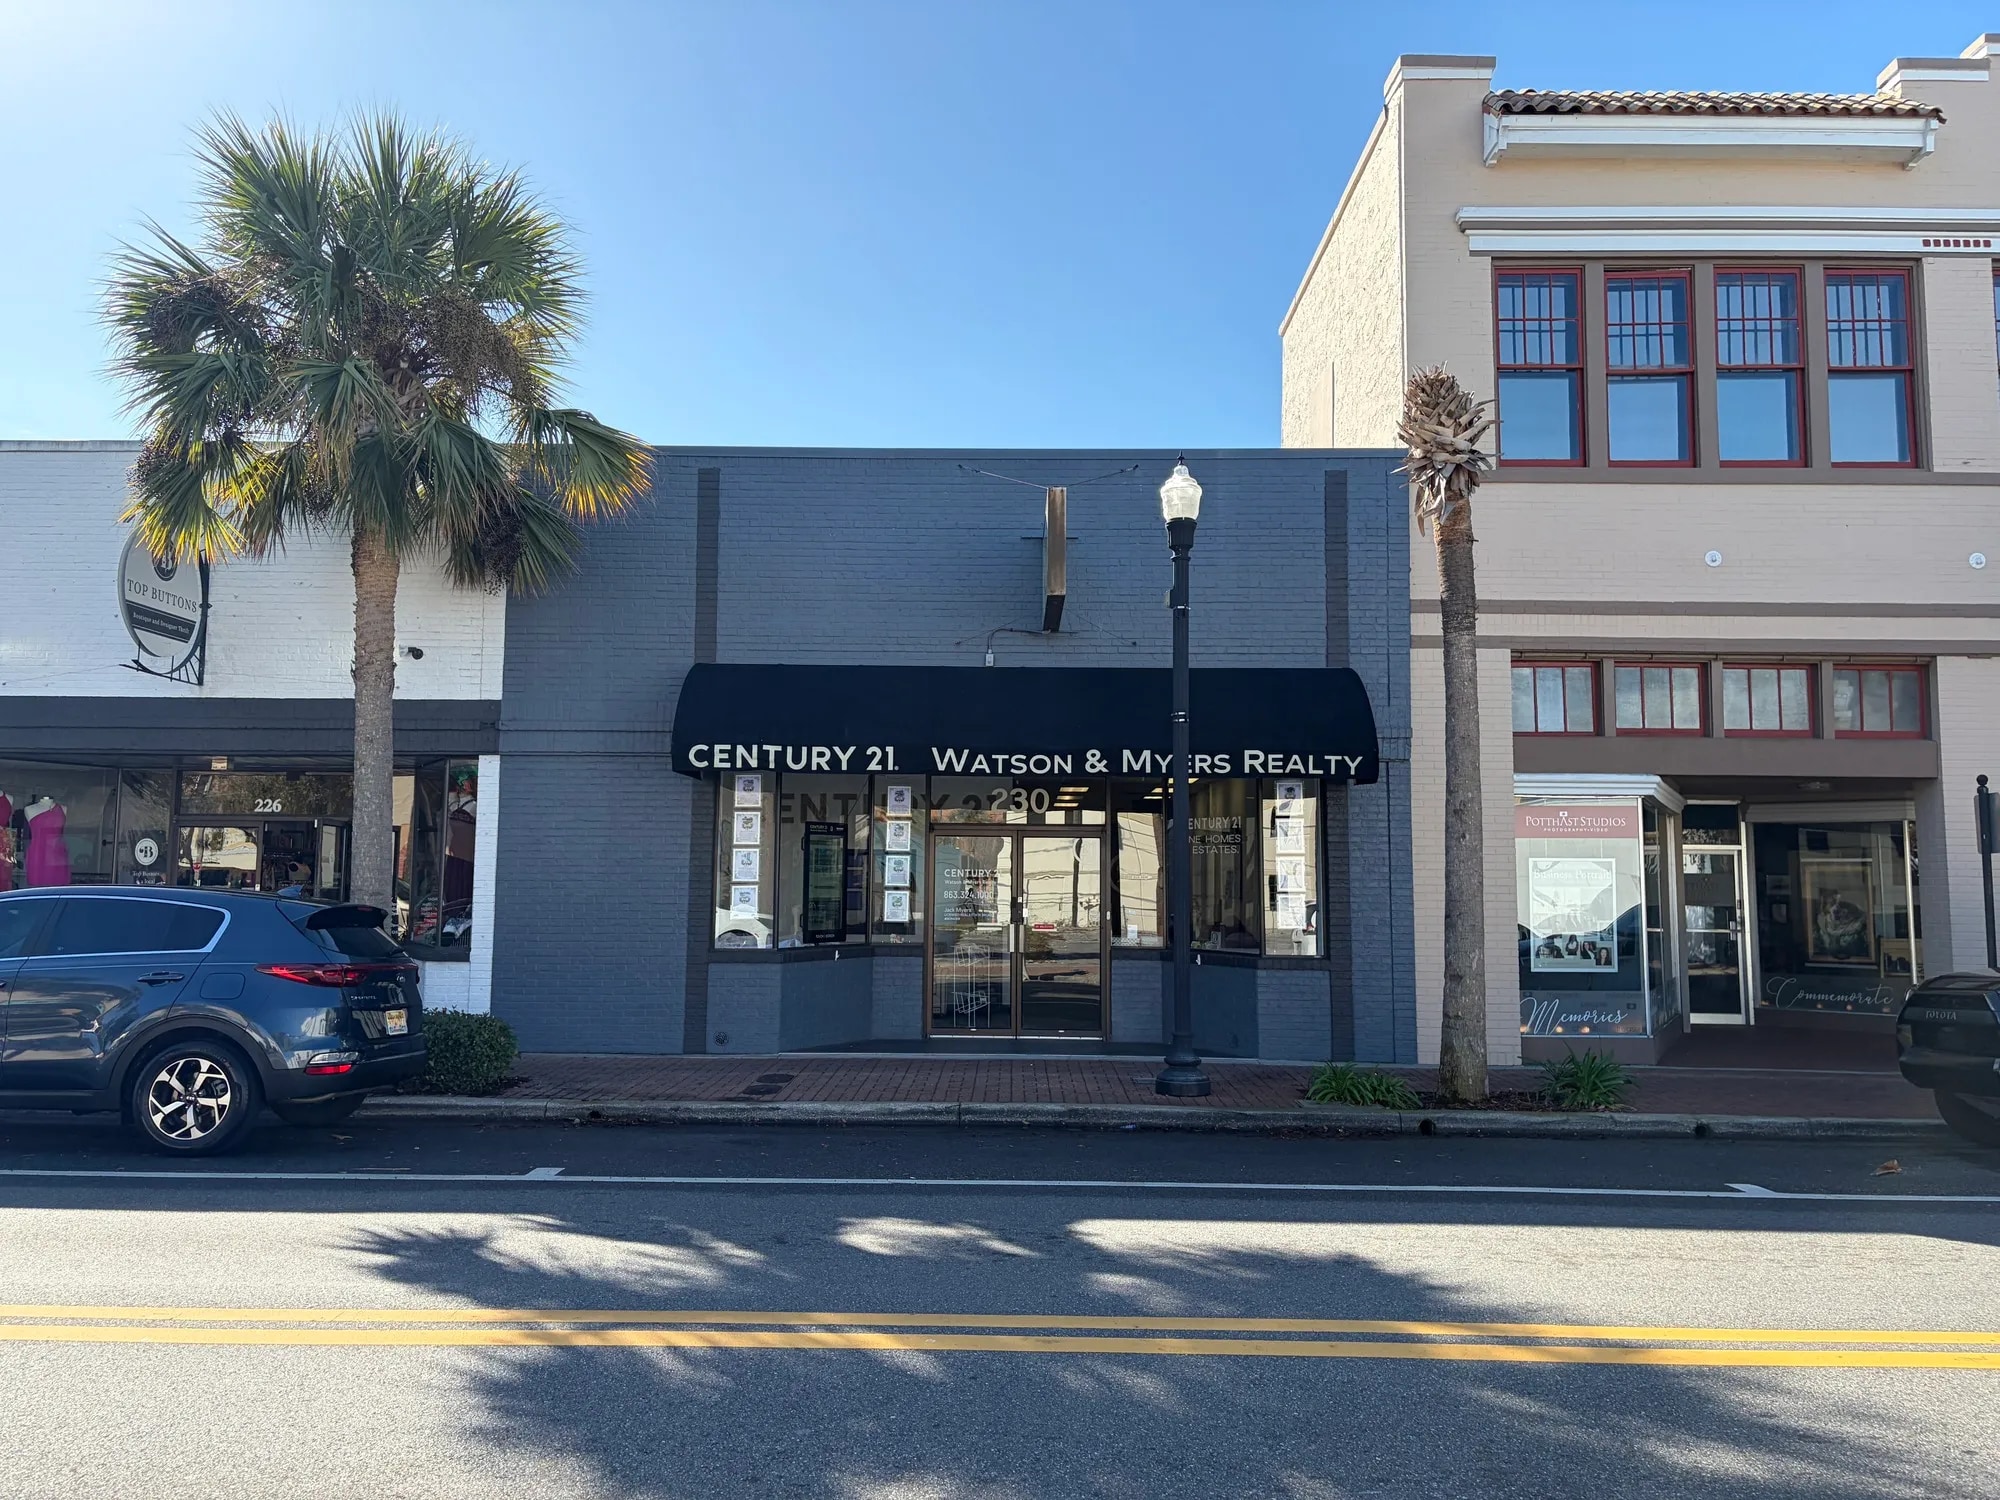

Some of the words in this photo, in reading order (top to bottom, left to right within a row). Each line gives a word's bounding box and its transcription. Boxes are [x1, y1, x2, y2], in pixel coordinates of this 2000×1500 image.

[127, 579, 148, 596] TOP
[151, 587, 197, 613] BUTTONS
[688, 744, 856, 771] CENTURY
[931, 747, 1072, 774] WATSON
[1084, 749, 1109, 774] &
[1122, 749, 1231, 774] MYRS
[1244, 749, 1363, 776] REALTY
[254, 799, 282, 812] 226
[991, 788, 1050, 814] 230
[1188, 816, 1229, 830] ENTURY
[1232, 816, 1241, 829] 21
[1525, 816, 1579, 827] POTTHAST
[1580, 816, 1626, 827] STUDIOS
[1189, 835, 1201, 844] NE
[1205, 834, 1242, 844] HOMES
[944, 868, 991, 878] CENTURY
[1766, 976, 1894, 1008] Commemorate
[1519, 997, 1628, 1035] Memories
[1925, 1010, 1957, 1020] TOYOTA
